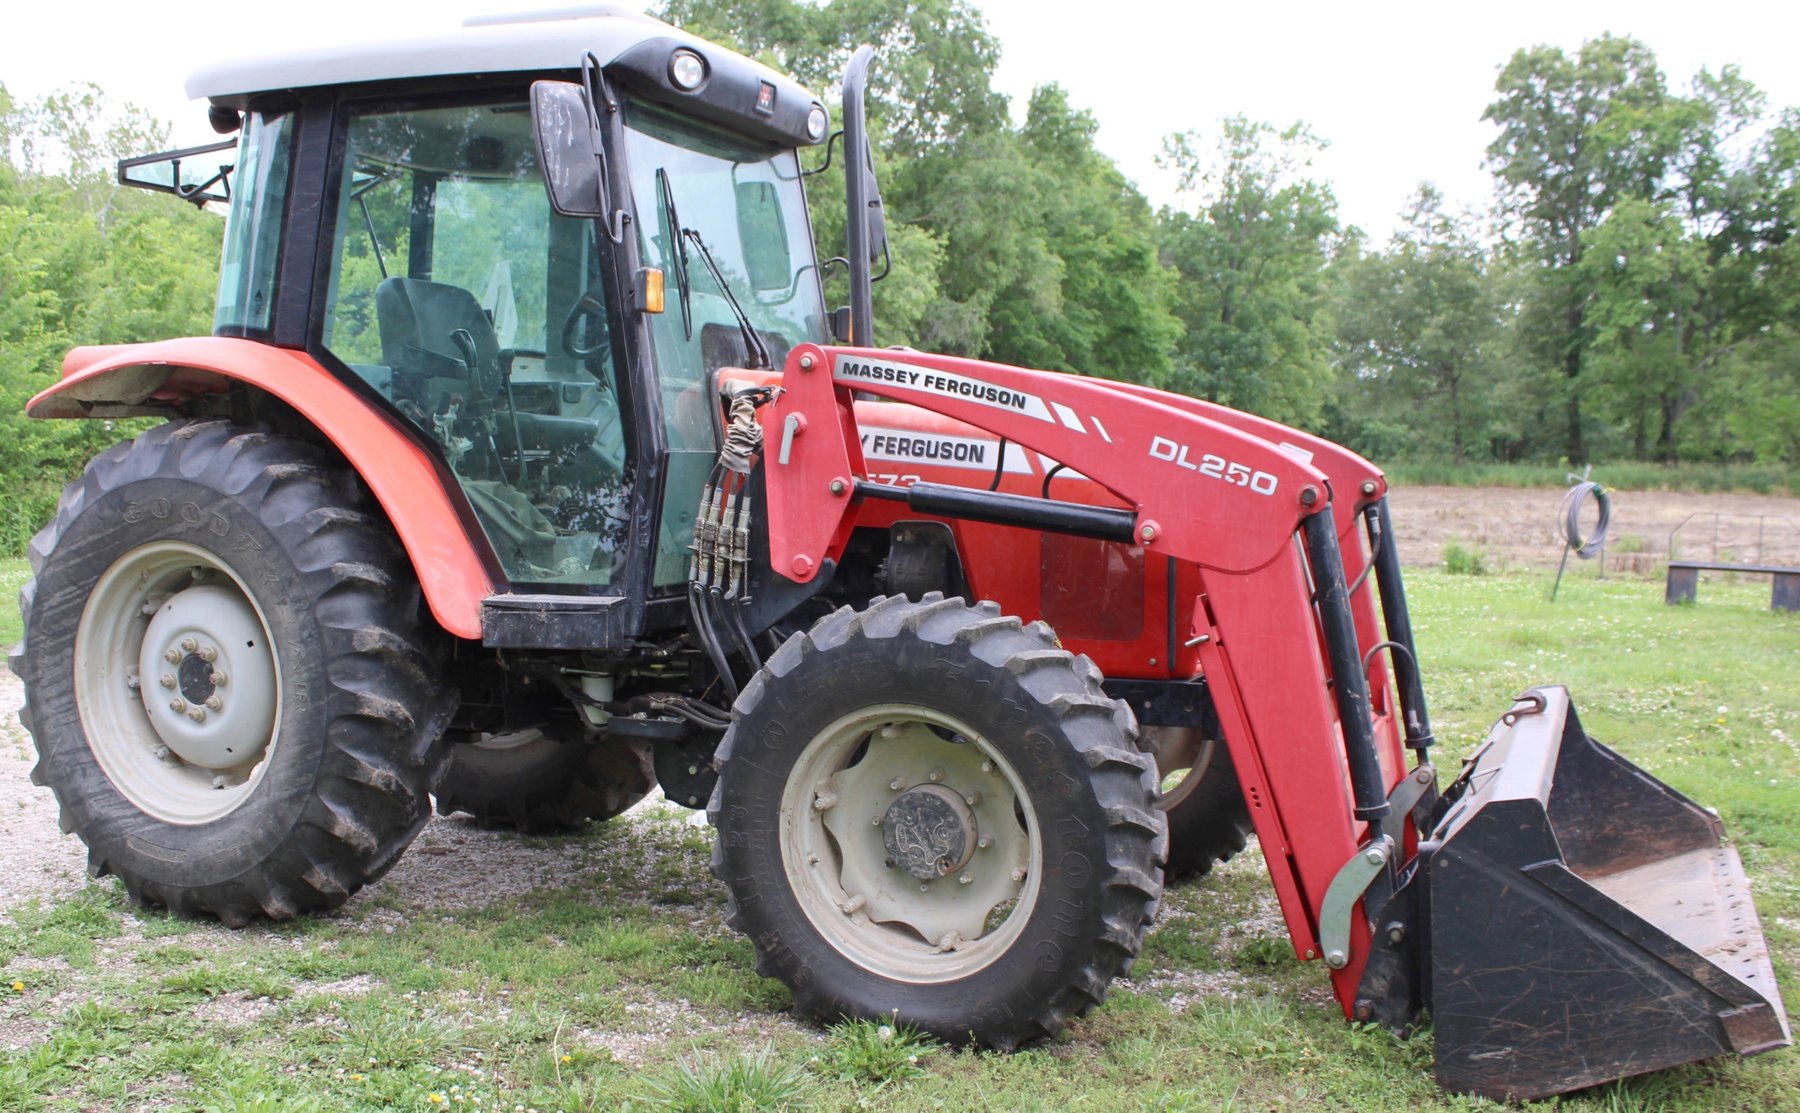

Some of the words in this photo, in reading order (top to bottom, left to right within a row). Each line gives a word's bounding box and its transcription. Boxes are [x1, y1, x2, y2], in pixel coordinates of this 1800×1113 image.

[843, 362, 919, 385] MASSEY
[924, 374, 1026, 409] FERGUSON
[872, 435, 985, 463] FERGUSON
[1149, 435, 1278, 496] DL250
